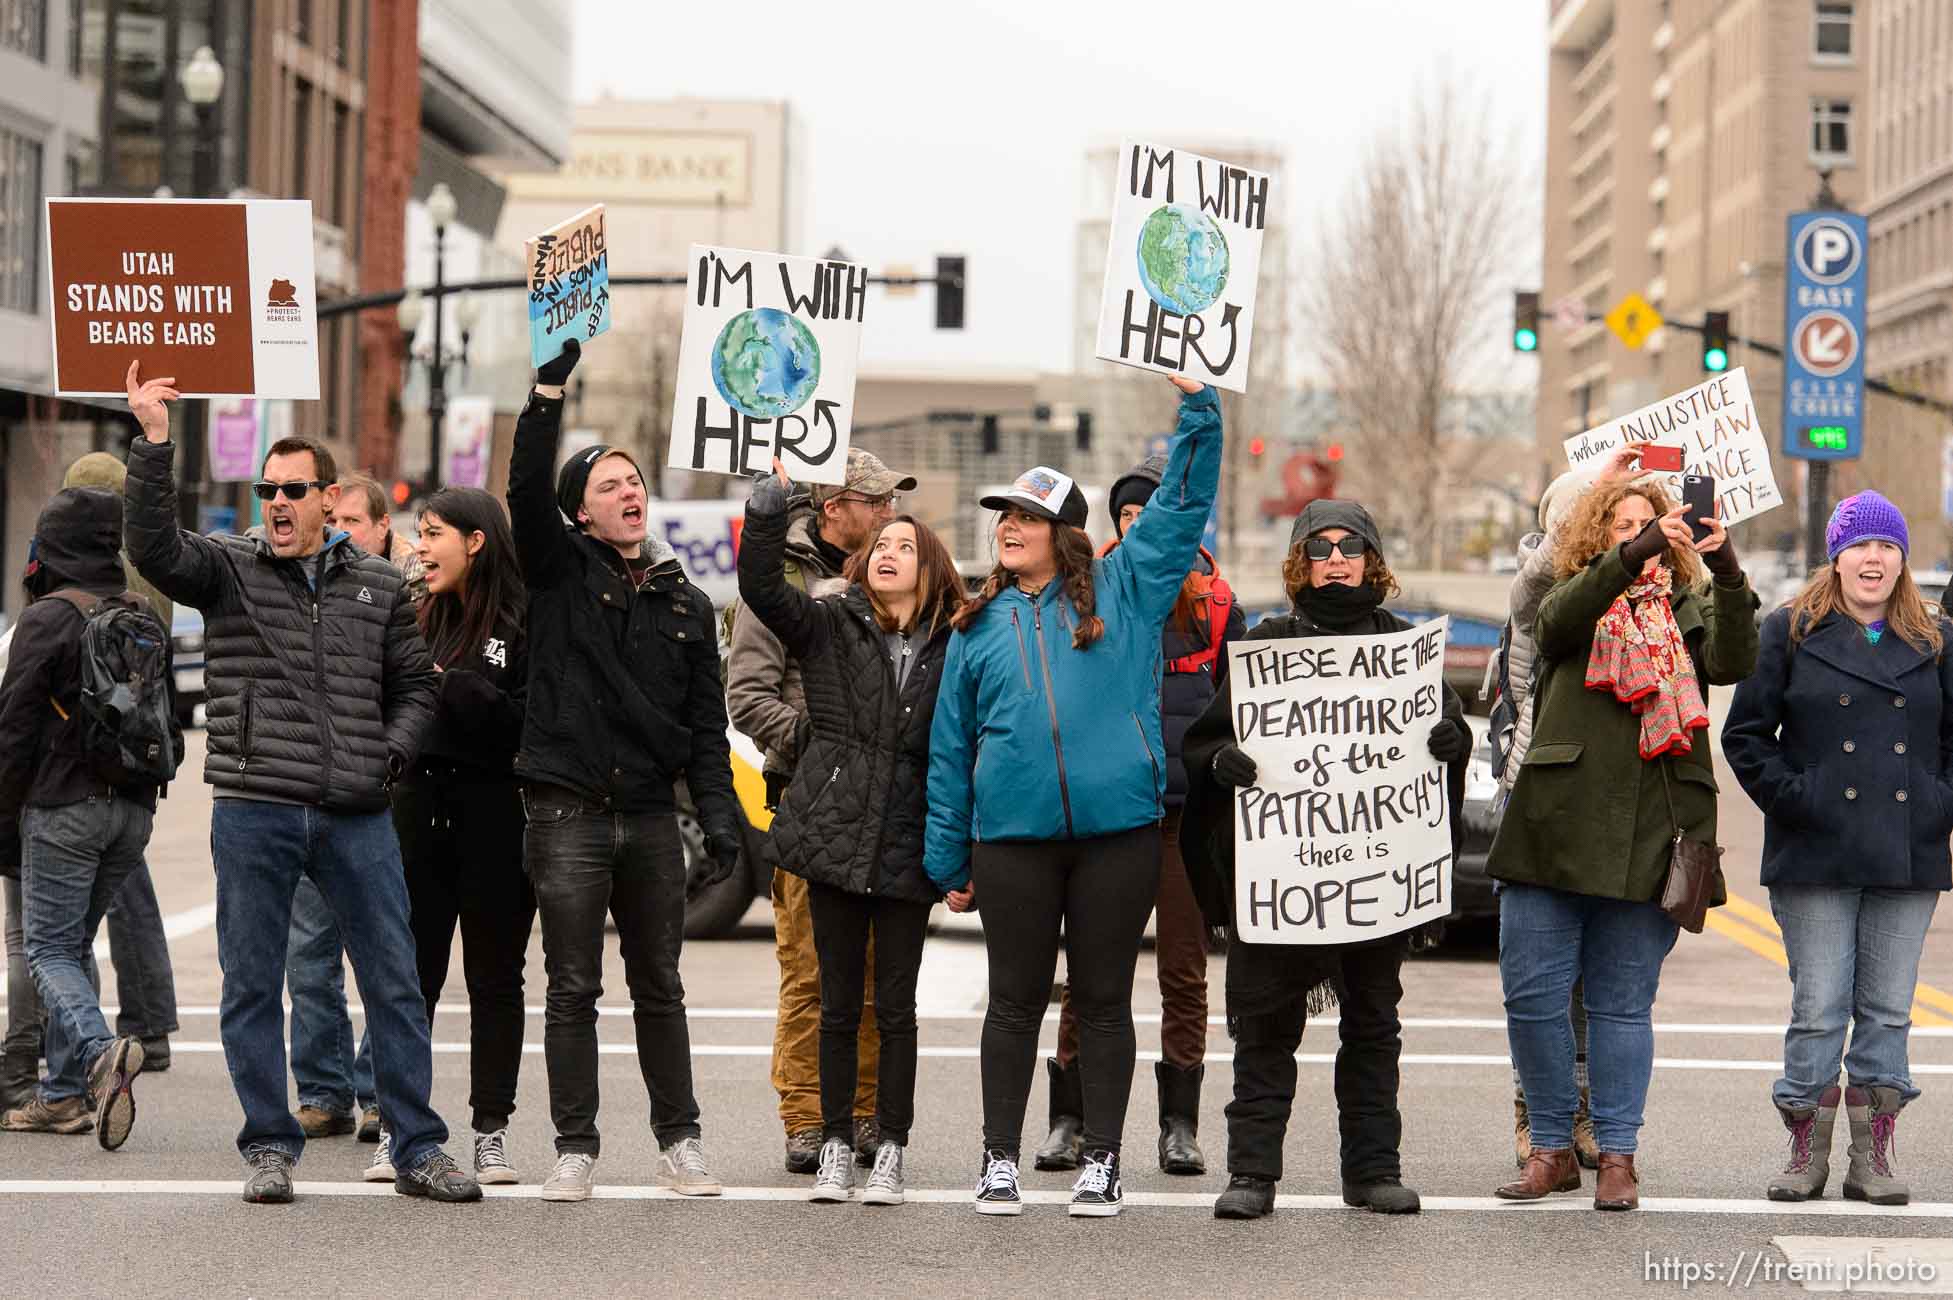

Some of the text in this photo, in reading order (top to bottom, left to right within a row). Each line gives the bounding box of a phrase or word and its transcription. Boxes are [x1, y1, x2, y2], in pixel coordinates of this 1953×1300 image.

[1131, 145, 1268, 229] I'M WITH
[122, 252, 174, 275] UTAH
[531, 235, 557, 304] HANDS
[548, 214, 604, 276] PUBLIC
[569, 249, 607, 288] LANDS
[67, 284, 232, 313] STANDS WITH
[544, 280, 592, 335] PUBLIC
[545, 274, 563, 304] IN
[588, 286, 609, 337] KEEP
[698, 251, 867, 322] I'M WITH
[1798, 287, 1854, 307] EAST
[88, 321, 216, 345] BEARS EARS
[1120, 290, 1206, 371] HER
[692, 396, 808, 475] HER
[1573, 377, 1735, 463] when INJUSTICE
[1696, 404, 1750, 453] LAW
[1236, 628, 1442, 688] THESE ARE THE
[1238, 684, 1437, 743] DEATHTHROES
[1294, 743, 1406, 787] of the
[1238, 766, 1443, 841] PATRIARCHY
[1294, 836, 1389, 868] there is
[1249, 853, 1452, 931] HOPE YET
